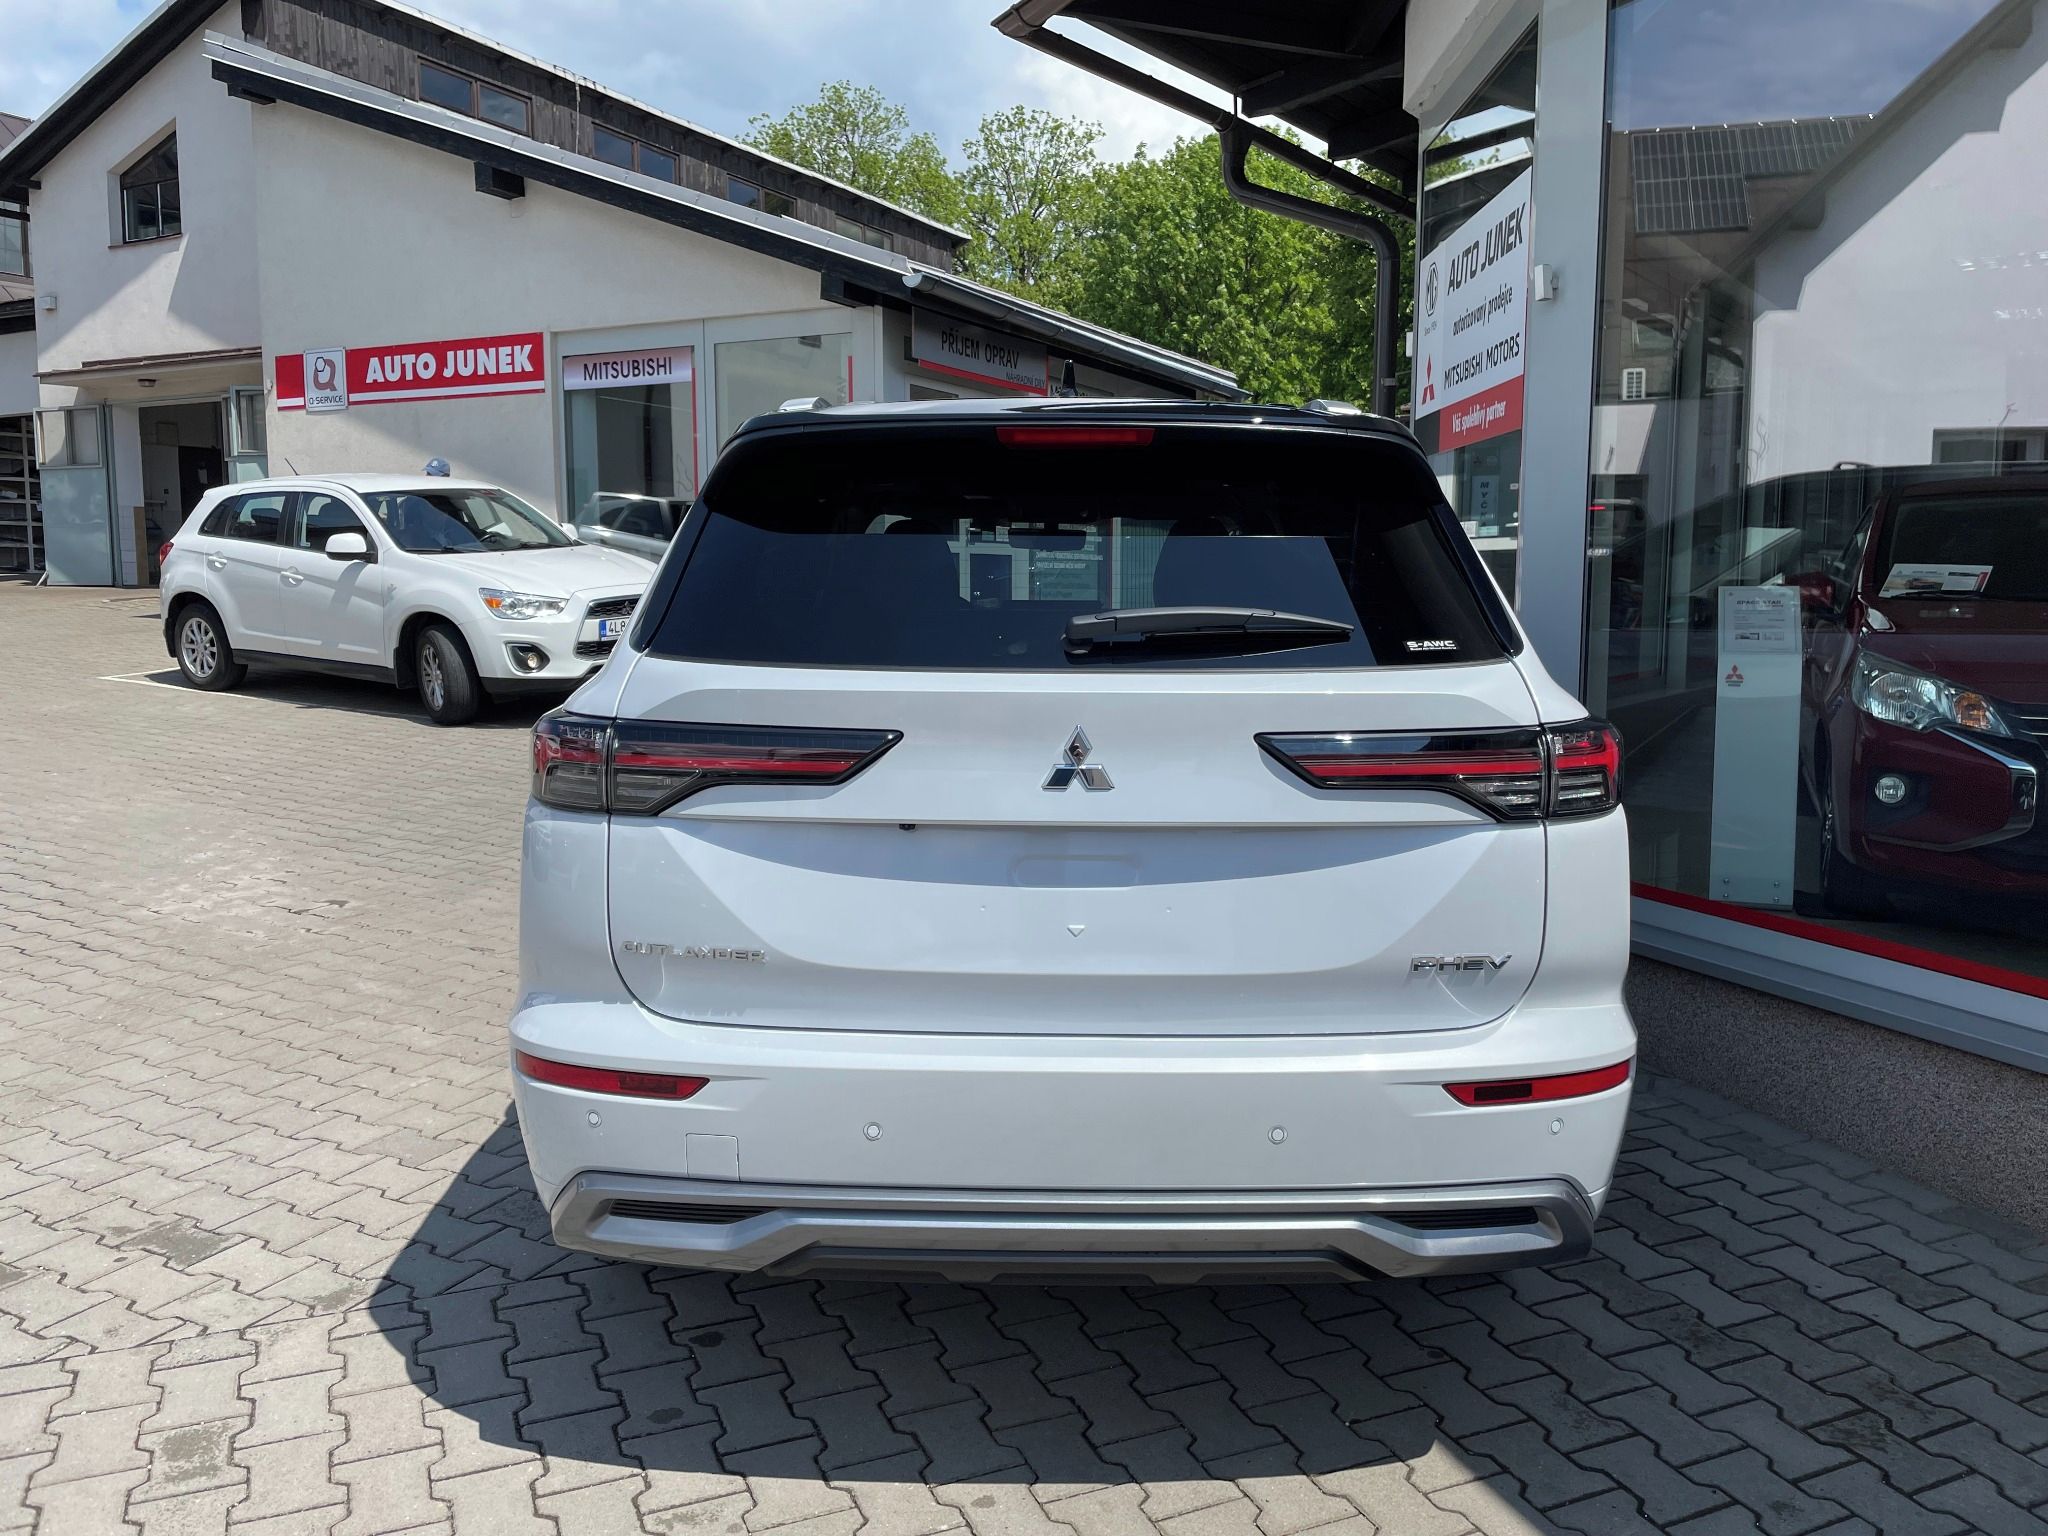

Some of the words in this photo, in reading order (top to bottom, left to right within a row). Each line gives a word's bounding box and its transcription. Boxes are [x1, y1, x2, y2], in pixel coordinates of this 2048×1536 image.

[1447, 240, 1479, 296] AUTO
[1480, 202, 1526, 272] JUNEK
[1453, 296, 1487, 336] autorizovaný
[1487, 283, 1512, 324] prodejce
[366, 353, 437, 384] AUTO
[443, 344, 534, 378] JUNEK
[941, 328, 980, 361] PŘÍJEM
[984, 343, 1020, 370] OPRAV
[1444, 352, 1483, 390] MITSUBISHI
[1486, 332, 1520, 371] MOTORS
[583, 356, 672, 381] MITSUBISHI
[1486, 400, 1507, 429] partner
[1406, 640, 1455, 648] S-AWC
[622, 940, 769, 965] OUTLANDER
[1411, 952, 1512, 972] PHEV
